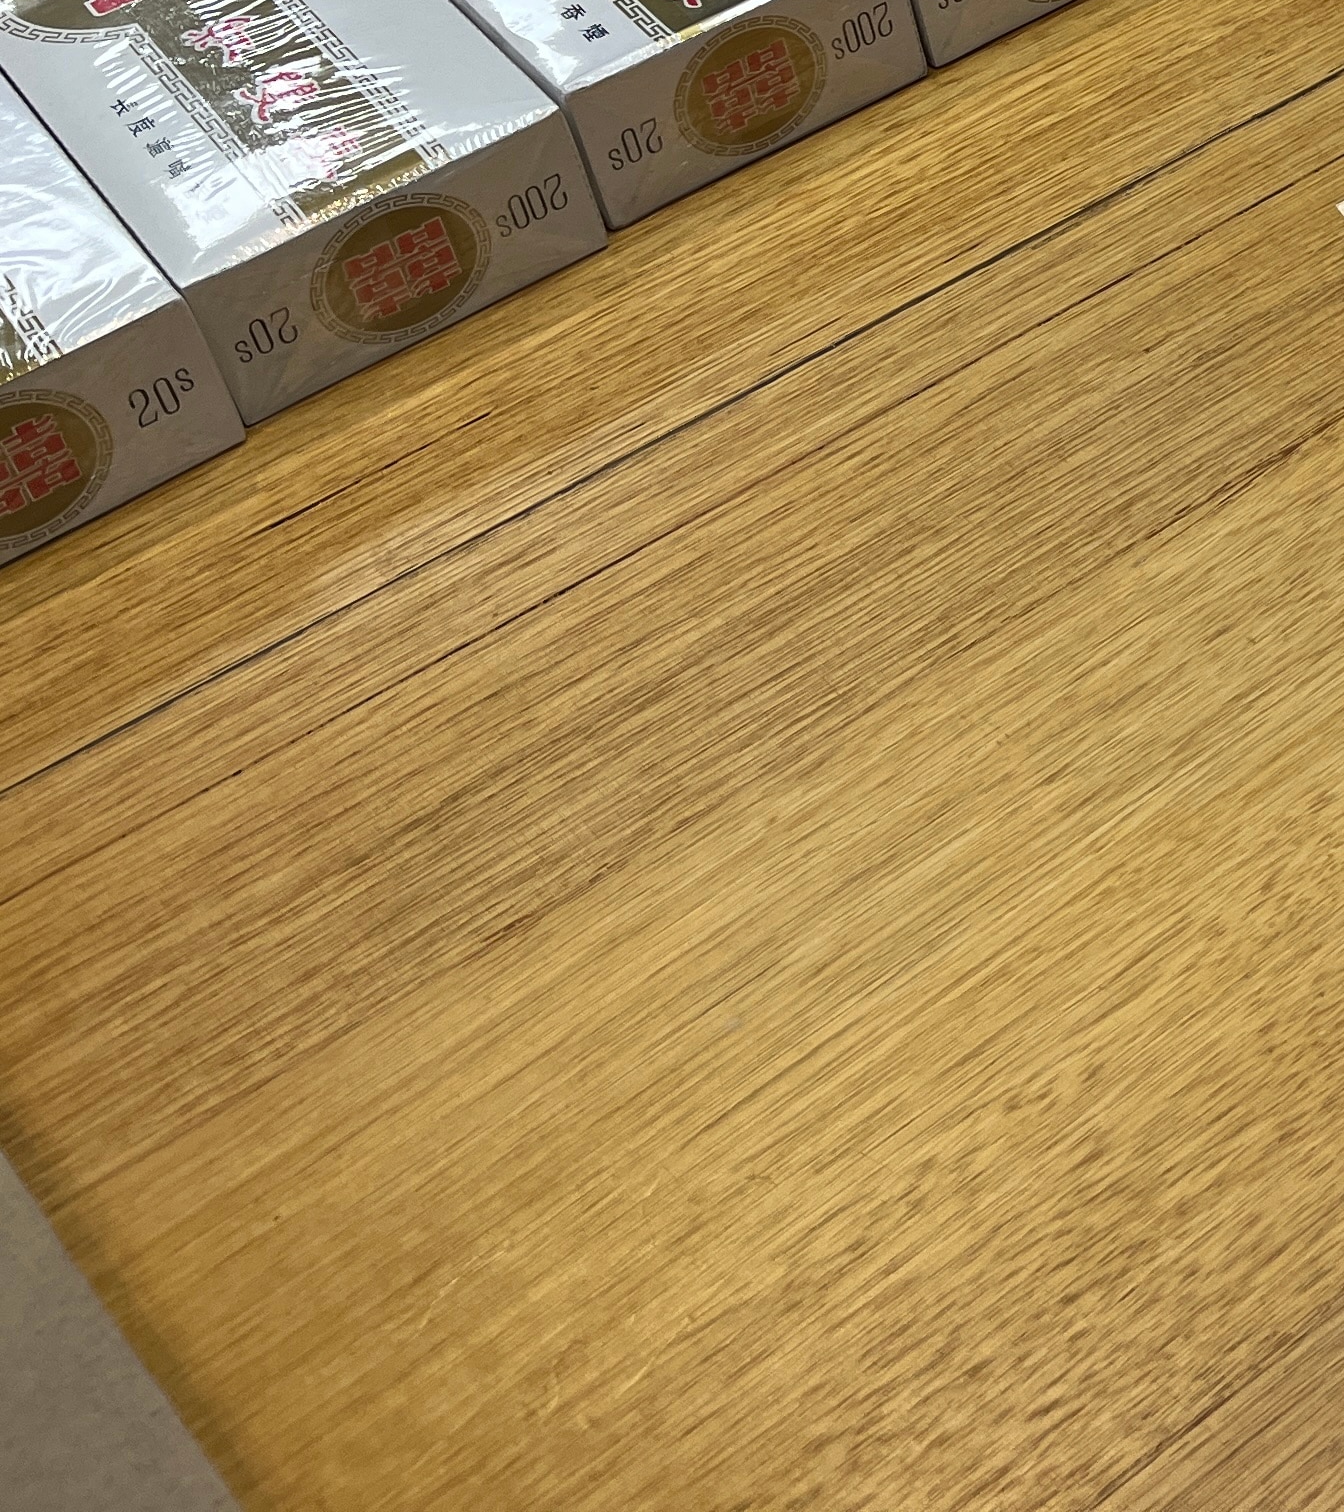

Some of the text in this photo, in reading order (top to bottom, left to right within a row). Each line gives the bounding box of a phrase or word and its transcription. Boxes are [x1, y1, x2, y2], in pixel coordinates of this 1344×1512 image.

[832, 1, 893, 60] 200s
[608, 117, 664, 172] 20s
[497, 173, 570, 240] 200s
[234, 306, 300, 364] 20s
[129, 365, 196, 429] 20s
